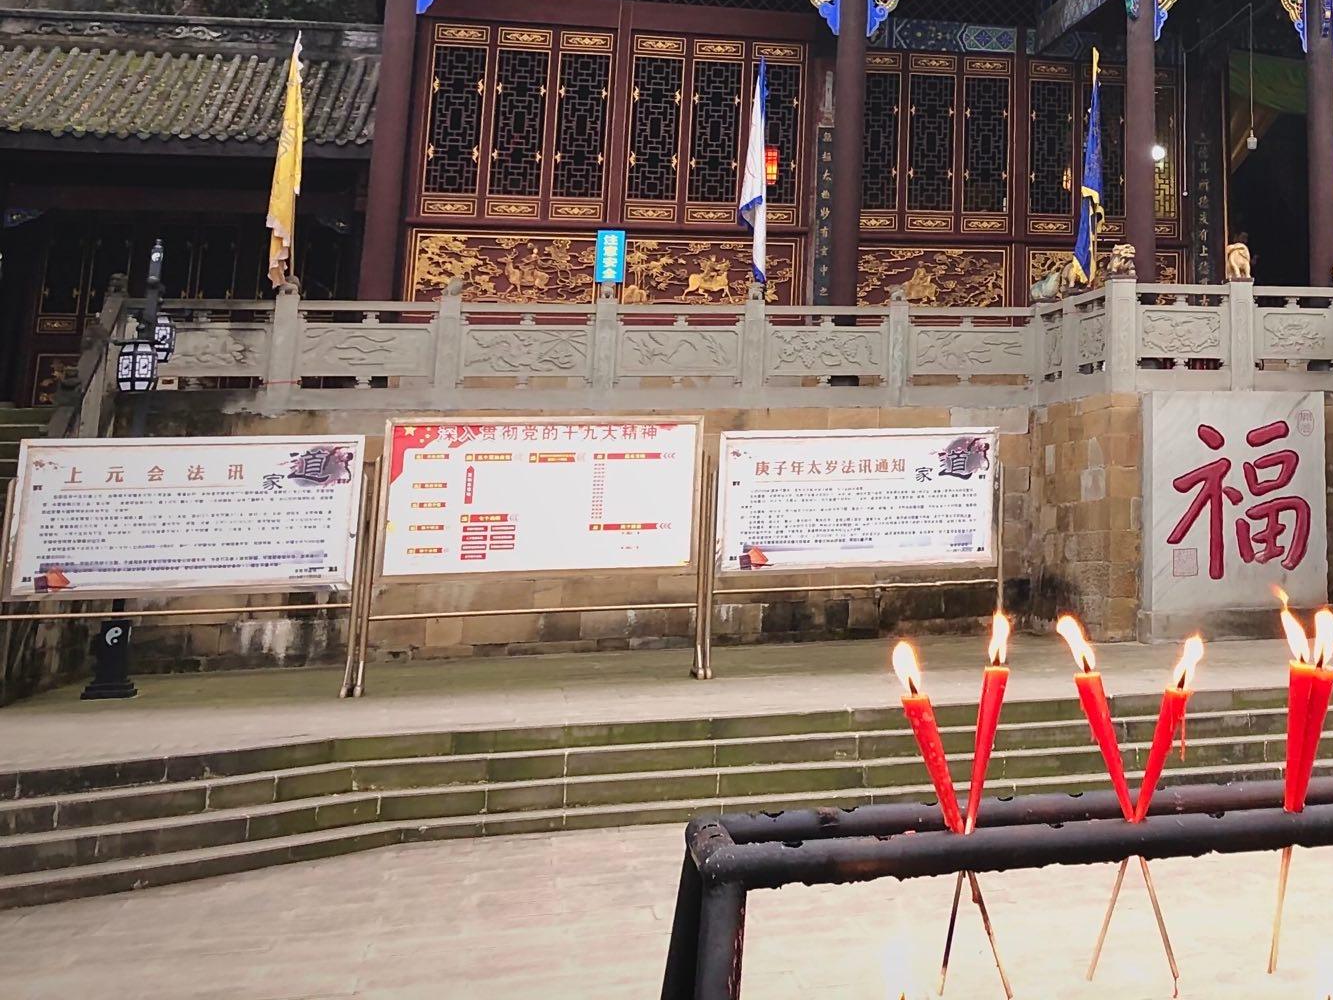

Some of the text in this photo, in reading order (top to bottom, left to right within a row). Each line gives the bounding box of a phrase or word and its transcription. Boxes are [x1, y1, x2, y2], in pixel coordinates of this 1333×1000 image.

[437, 424, 658, 441] 深入贯彻党的十九大精神
[63, 464, 246, 485] 上元会法讯
[755, 458, 906, 476] 庚子年太岁法讯通知
[1166, 421, 1311, 579] 福
